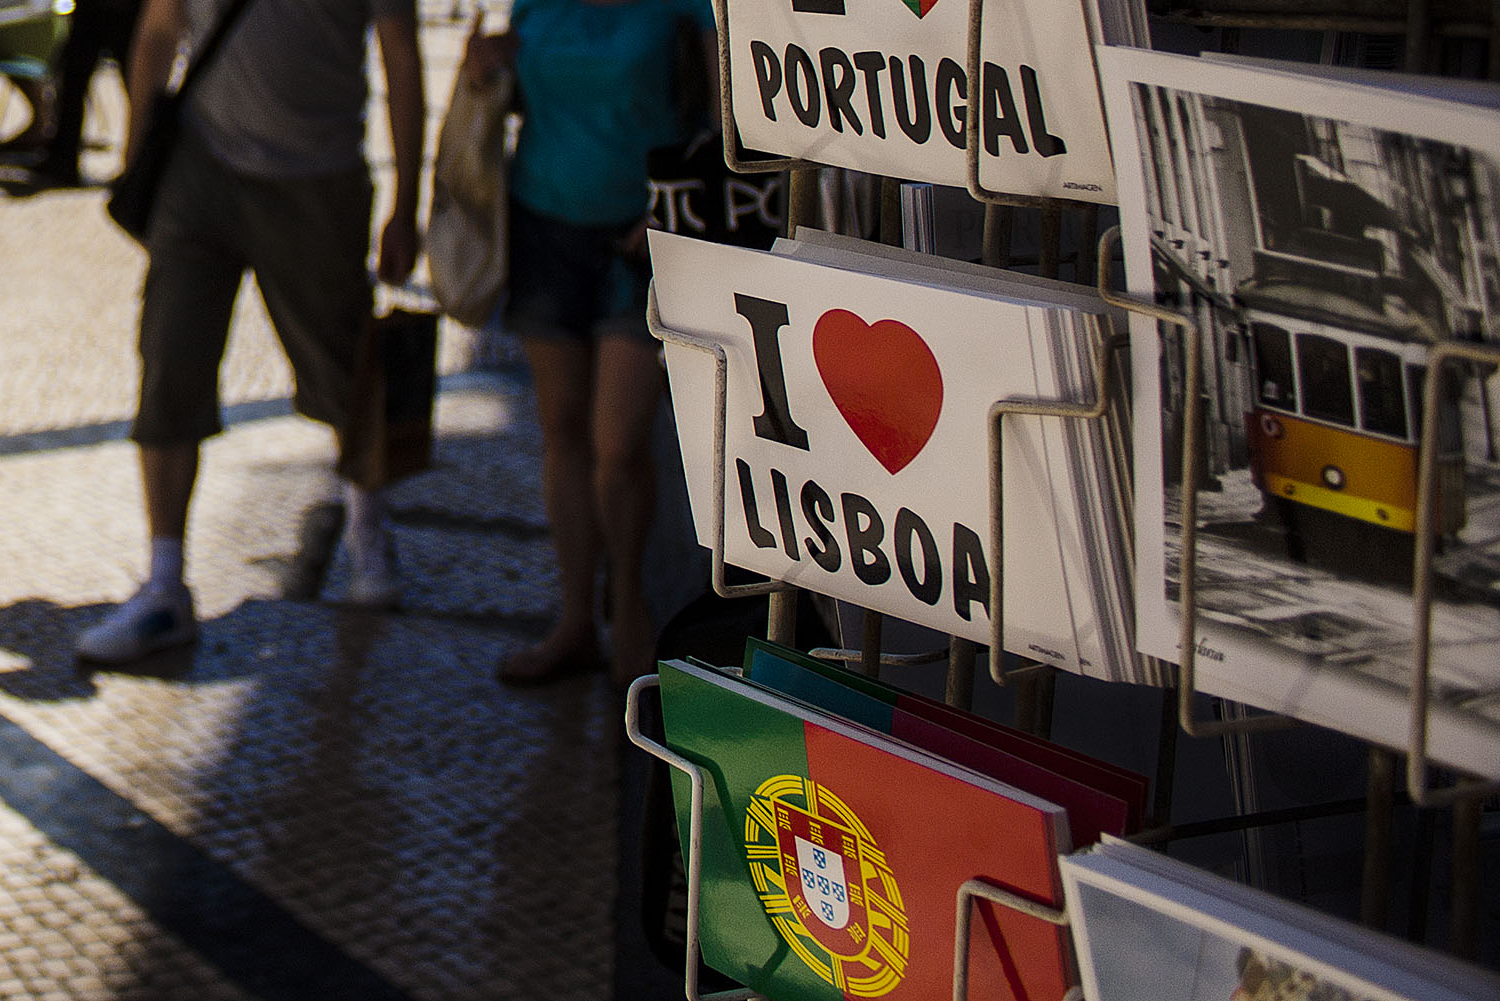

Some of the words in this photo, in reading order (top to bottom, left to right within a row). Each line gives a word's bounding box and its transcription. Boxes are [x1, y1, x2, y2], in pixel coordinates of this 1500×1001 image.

[750, 40, 1067, 158] PORTUGAL
[734, 292, 810, 451] I
[736, 457, 991, 622] LISBOA
